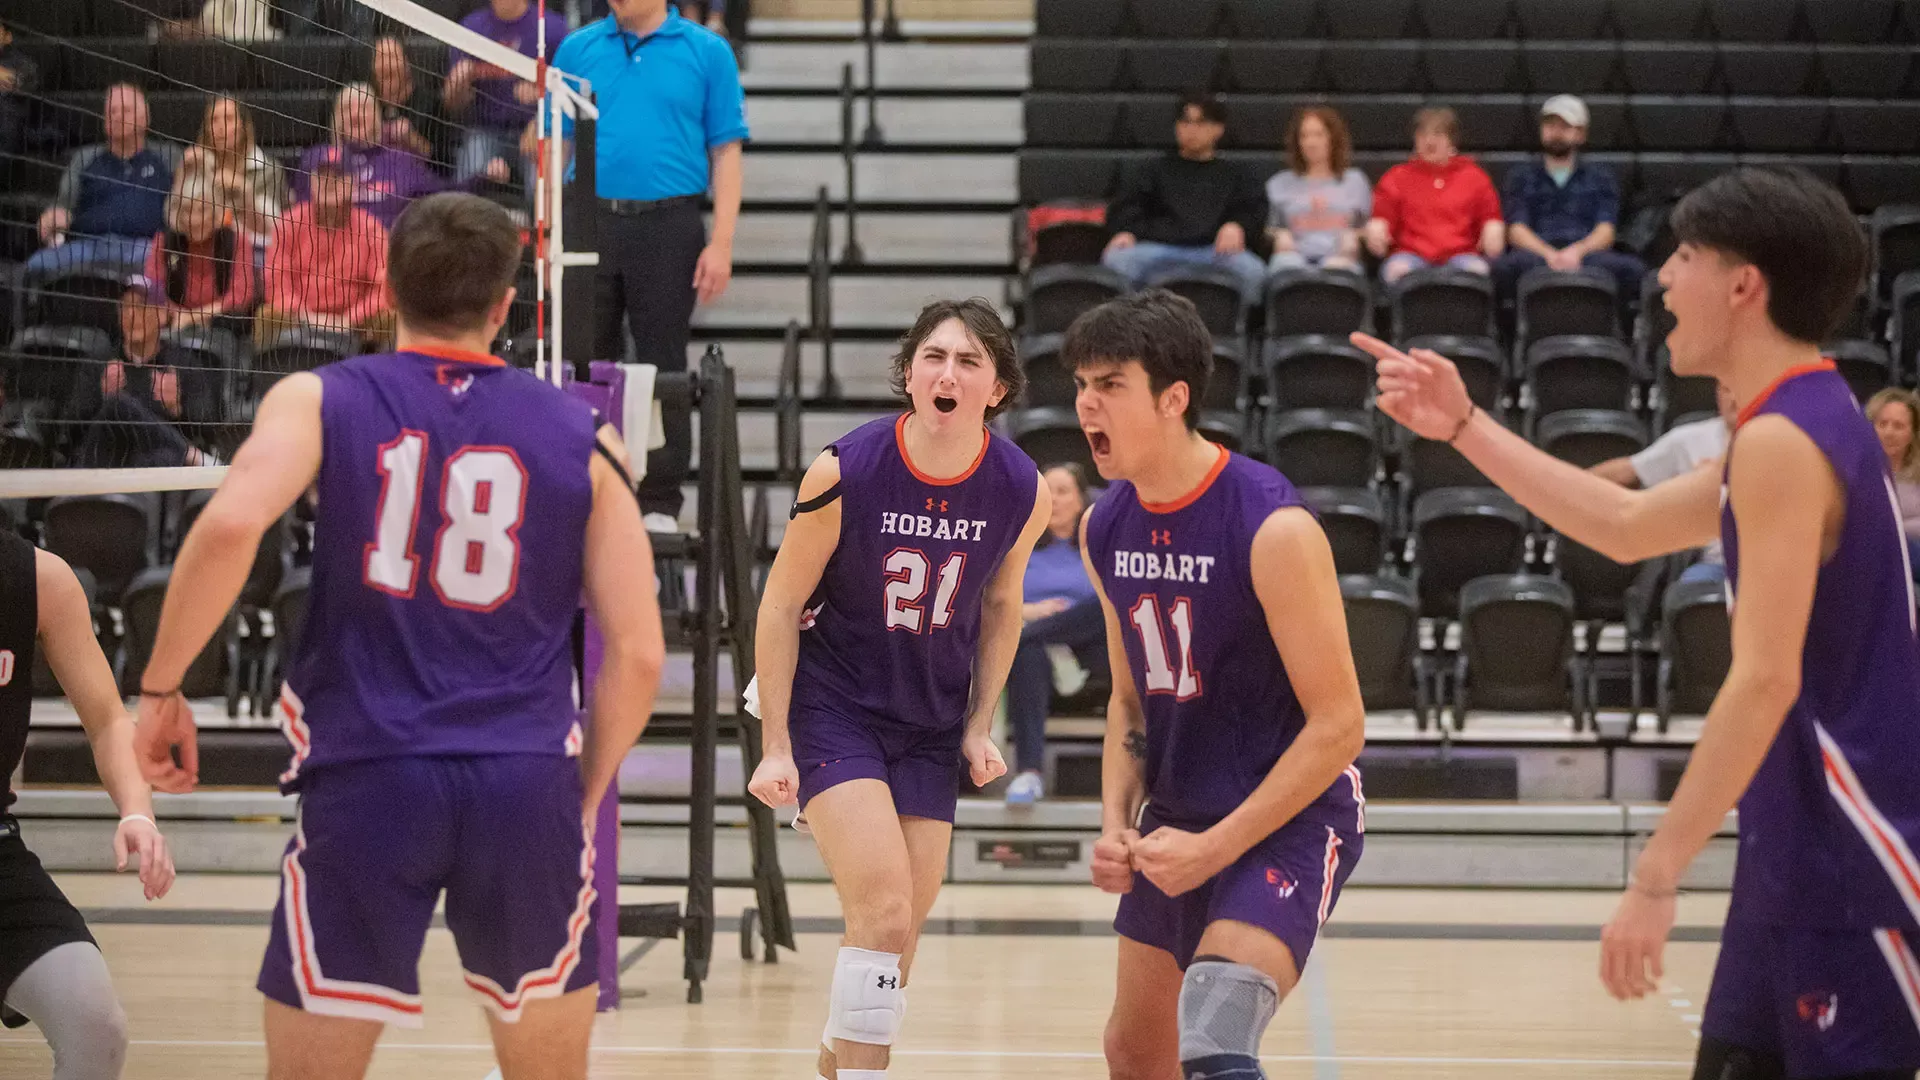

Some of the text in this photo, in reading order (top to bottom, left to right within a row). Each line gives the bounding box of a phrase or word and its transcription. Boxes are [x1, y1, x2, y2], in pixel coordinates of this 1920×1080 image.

[363, 428, 529, 613] 18
[880, 511, 987, 541] HOBART
[882, 546, 967, 636] 21
[1114, 550, 1215, 583] HOBART
[1128, 593, 1202, 702] 11
